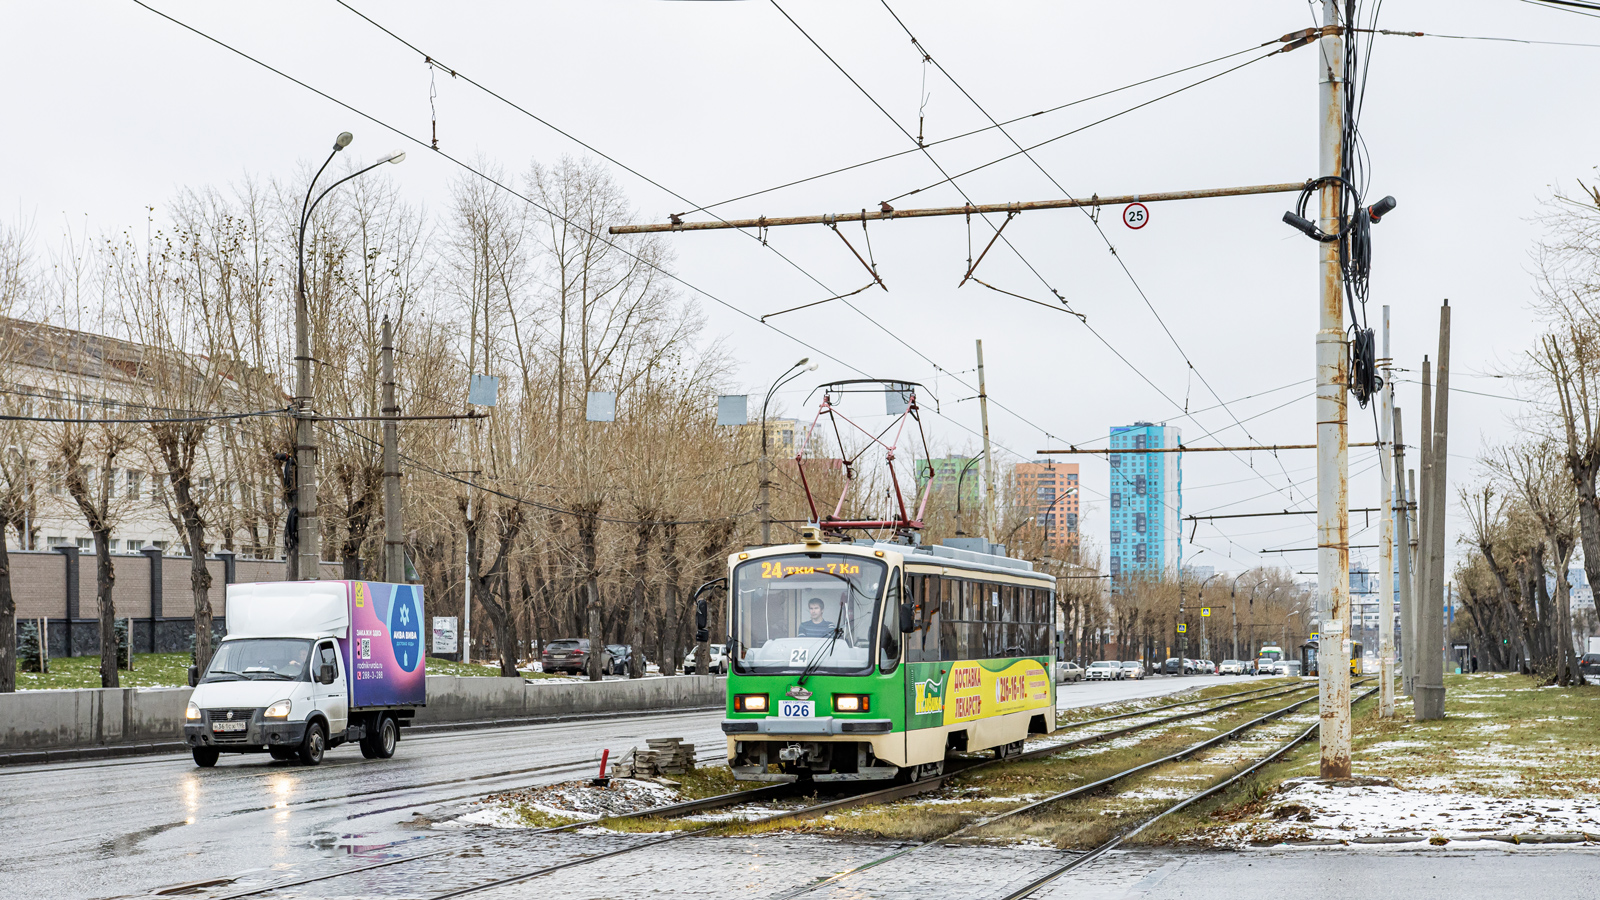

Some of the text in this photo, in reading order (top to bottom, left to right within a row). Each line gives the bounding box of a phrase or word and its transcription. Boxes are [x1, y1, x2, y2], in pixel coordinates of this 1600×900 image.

[1128, 210, 1144, 222] 25
[761, 561, 783, 579] 24
[839, 563, 860, 574] Кл
[393, 631, 417, 639] АКВА ВИВА
[791, 649, 807, 662] 24
[954, 667, 982, 693] ДОСТАВКА
[1000, 675, 1025, 702] 216-16-16
[784, 705, 810, 717] 026
[954, 695, 982, 719] ЛЕКАРСТВ
